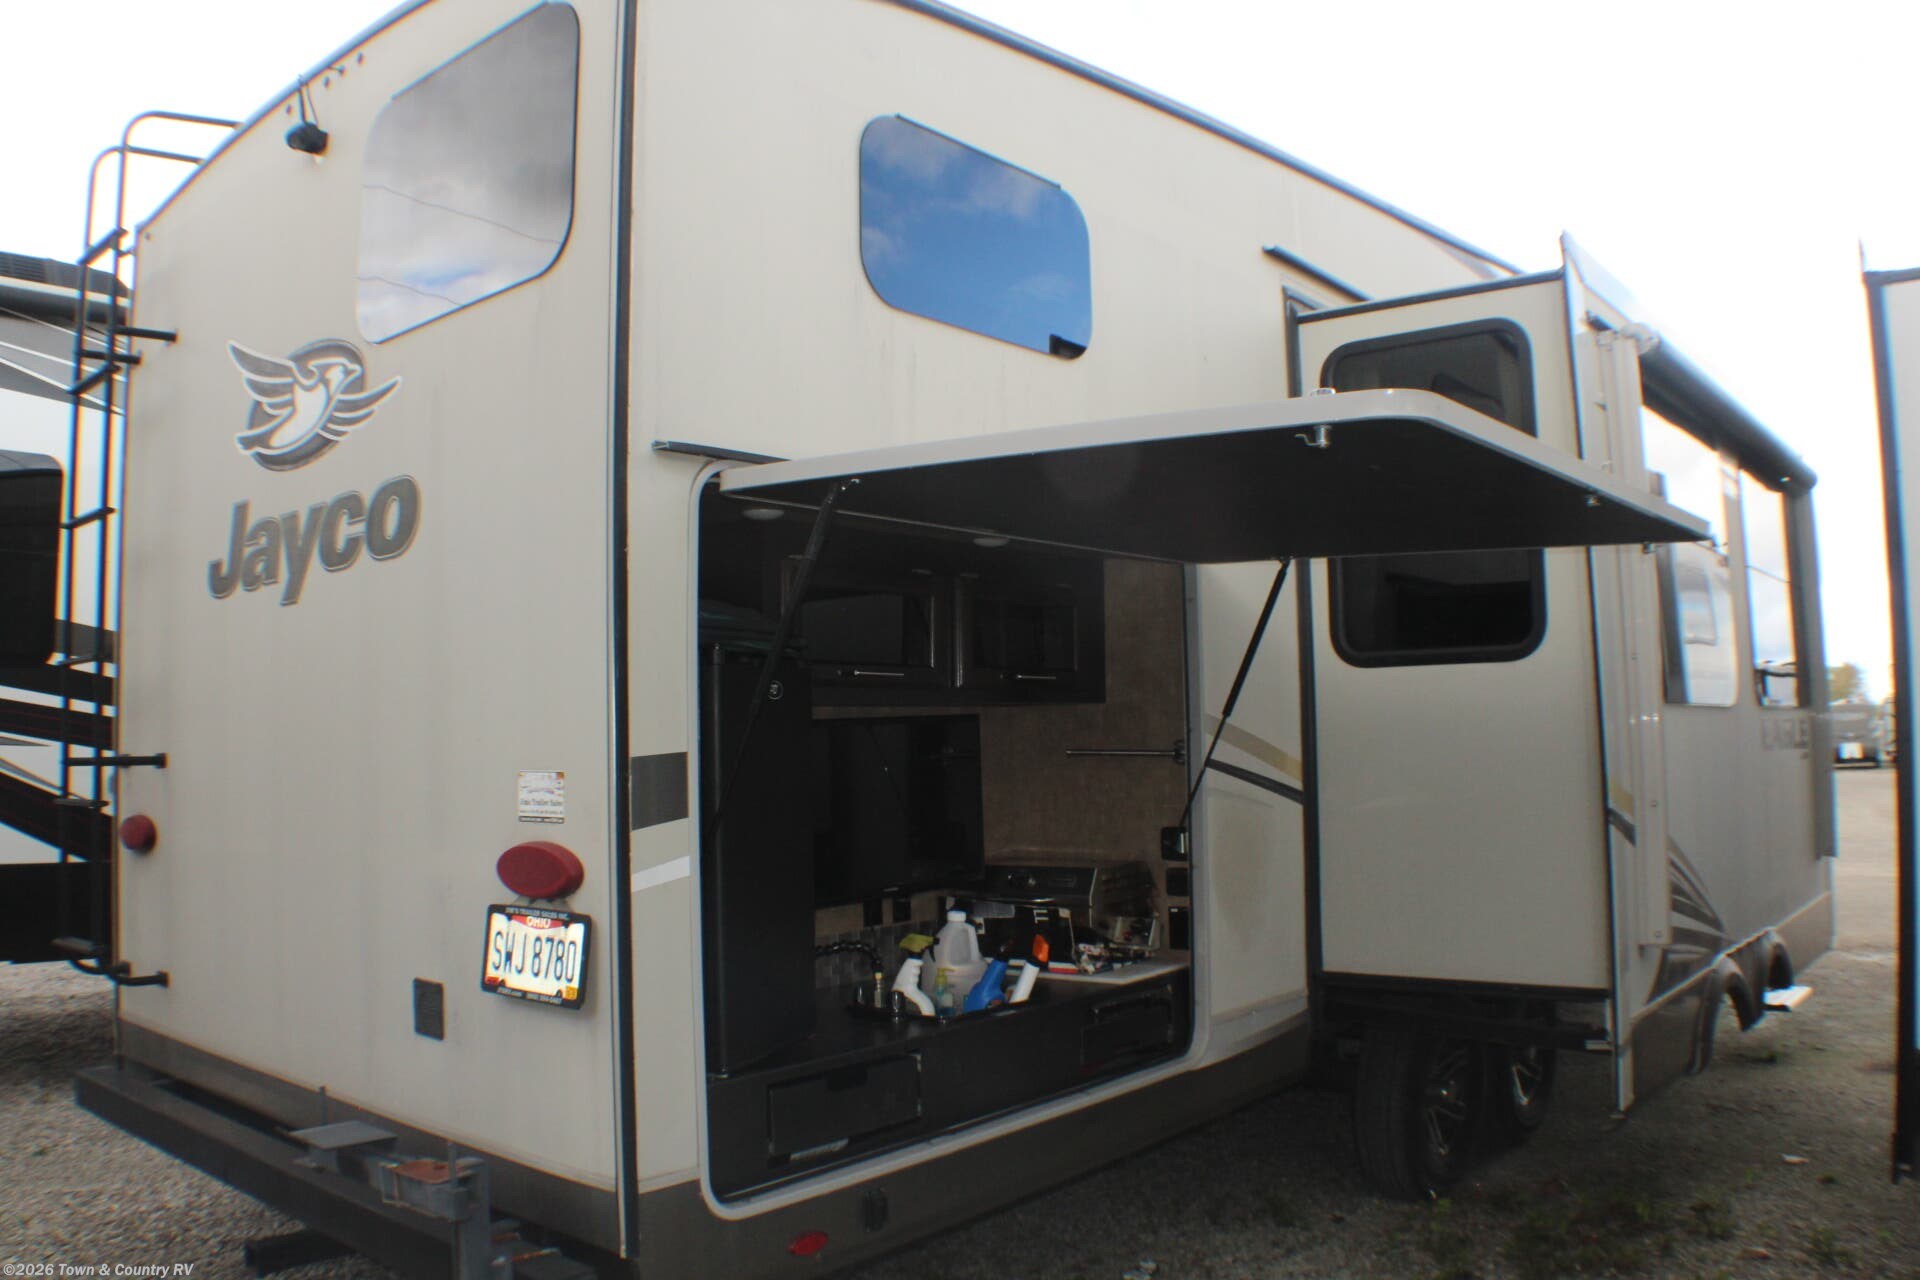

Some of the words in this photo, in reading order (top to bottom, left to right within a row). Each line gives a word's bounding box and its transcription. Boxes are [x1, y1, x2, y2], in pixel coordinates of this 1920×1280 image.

[208, 475, 421, 606] Jayco
[526, 916, 552, 929] OHIO
[492, 931, 527, 974] SWJ
[531, 936, 577, 983] 8780
